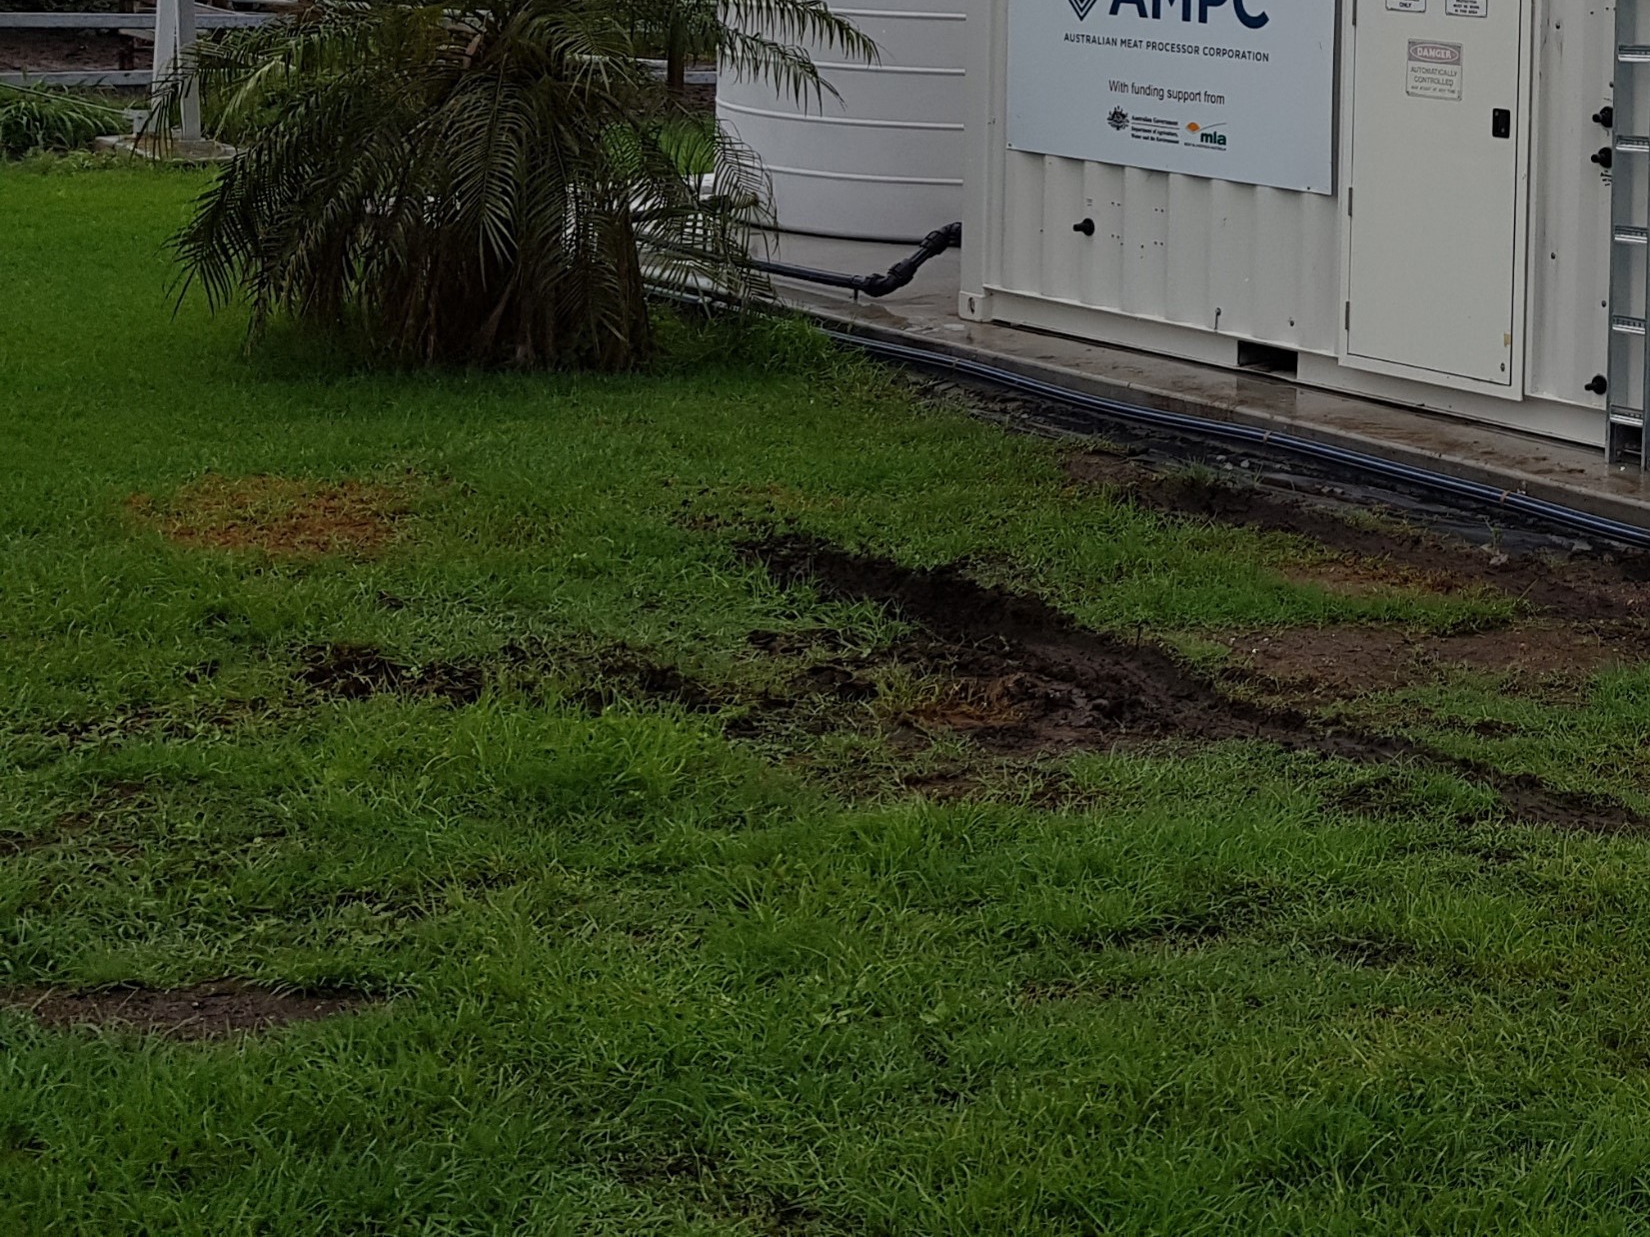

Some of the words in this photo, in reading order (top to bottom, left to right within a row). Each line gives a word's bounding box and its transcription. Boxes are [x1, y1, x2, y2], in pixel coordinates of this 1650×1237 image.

[1063, 32, 1118, 47] AUSTRALIAN
[1120, 39, 1143, 50] MEAT
[1145, 40, 1200, 56] PROCESSOR
[1202, 46, 1270, 62] CORPORATION
[1416, 47, 1452, 59] DANGER
[1410, 66, 1457, 77] AUTOMATICALLY
[1413, 75, 1453, 86] CONTROLLED
[1108, 80, 1129, 93] With
[1131, 82, 1164, 100] funding
[1167, 88, 1201, 103] support
[1203, 90, 1225, 105] from
[1200, 131, 1227, 146] mla
